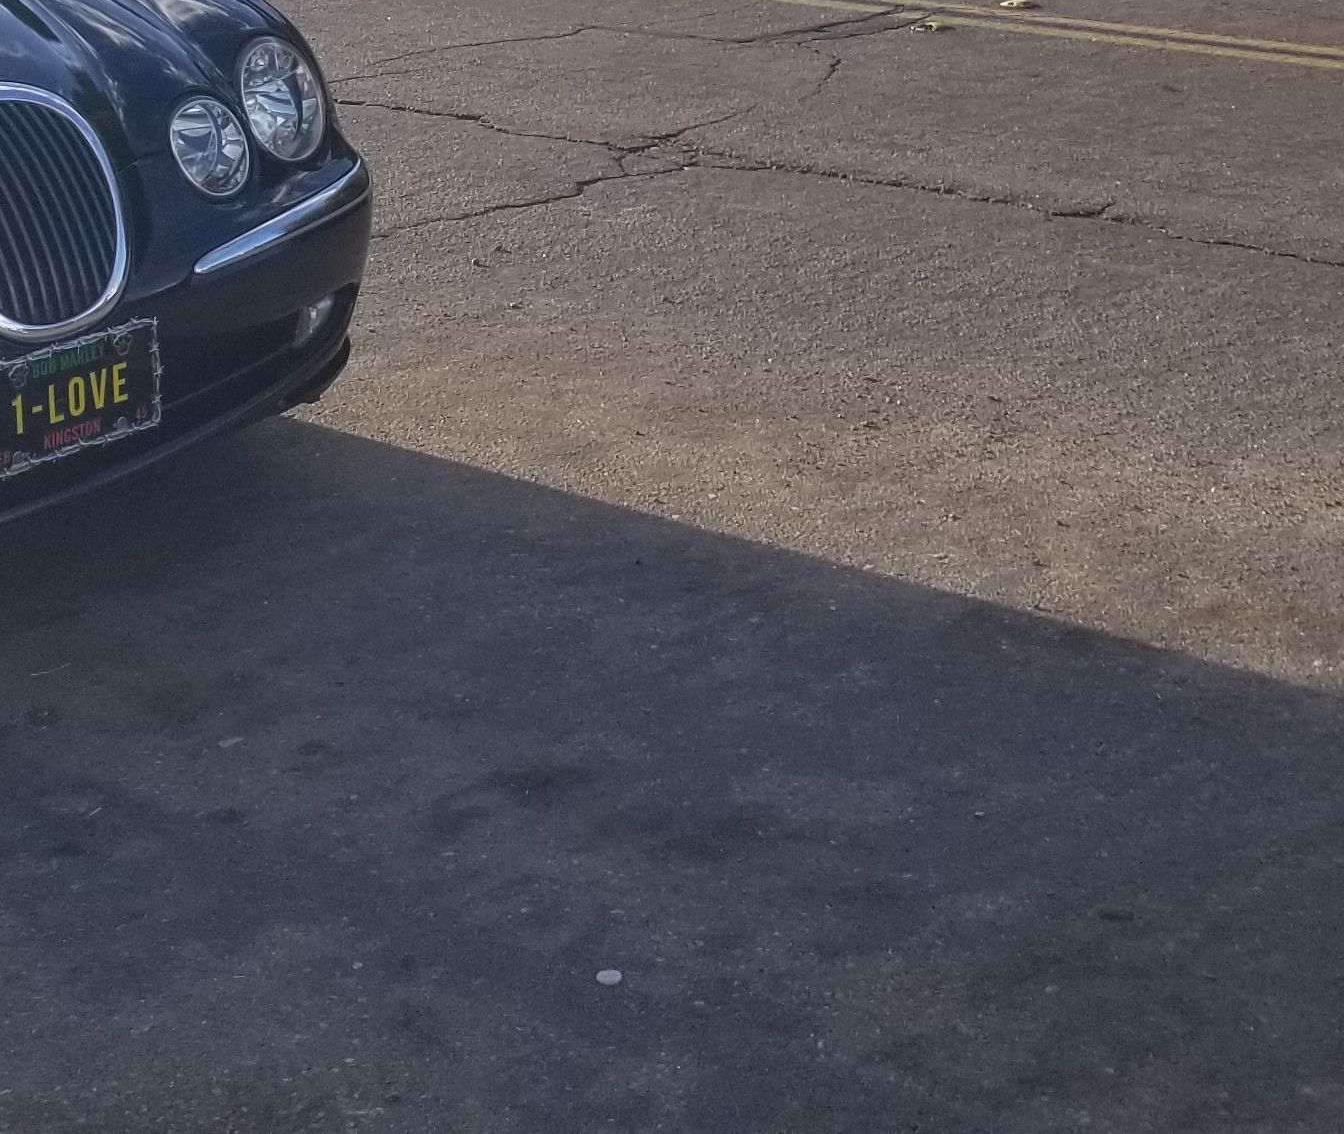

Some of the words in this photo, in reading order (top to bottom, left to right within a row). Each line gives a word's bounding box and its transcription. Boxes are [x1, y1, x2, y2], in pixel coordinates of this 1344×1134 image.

[32, 355, 57, 378] BOB
[59, 340, 105, 370] MARLEY
[11, 362, 129, 435] 1-LOVE
[43, 418, 103, 450] KINGSTON
